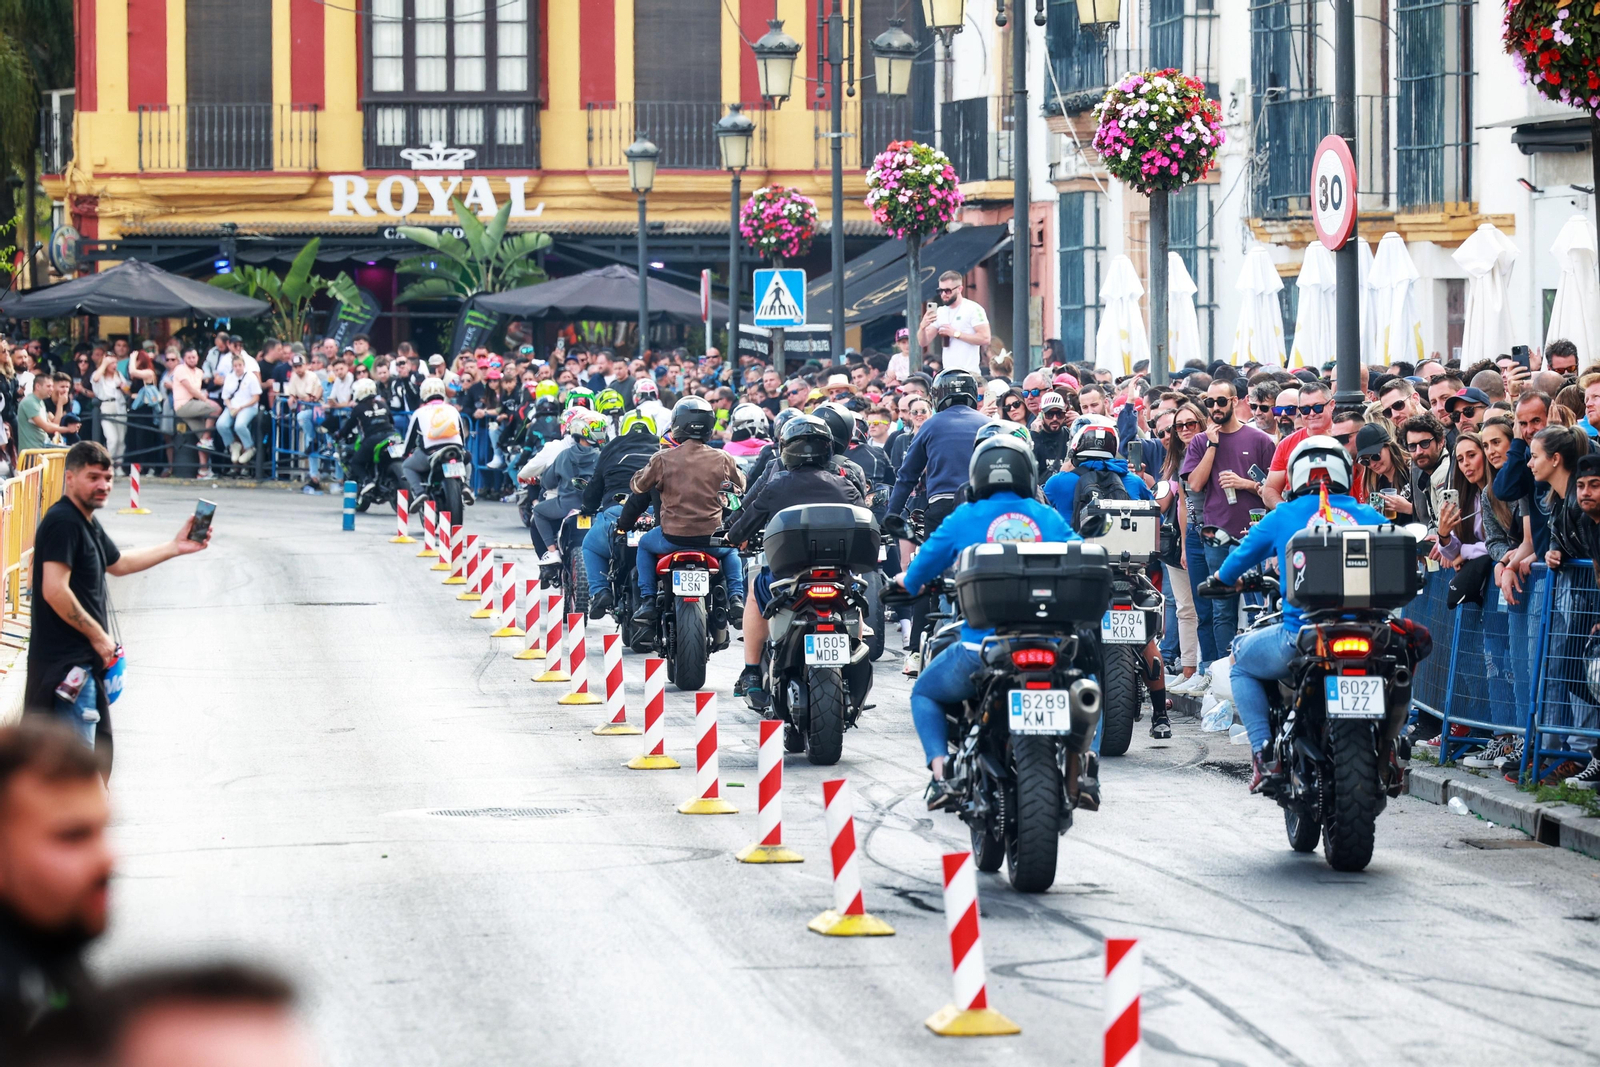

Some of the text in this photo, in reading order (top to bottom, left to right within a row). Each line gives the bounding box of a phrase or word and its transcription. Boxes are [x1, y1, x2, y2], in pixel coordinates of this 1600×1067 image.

[328, 175, 545, 217] ROYAL
[1319, 174, 1342, 211] 30
[681, 572, 707, 583] 3925
[681, 582, 701, 592] LSN
[1112, 613, 1142, 625] 5784
[1112, 626, 1135, 638] KDX
[817, 637, 846, 649] 1605
[816, 649, 839, 661] MDB
[1340, 680, 1379, 695] 6027
[1023, 694, 1066, 709] 6289
[1341, 696, 1370, 711] LZZ
[1024, 711, 1055, 726] KMT
